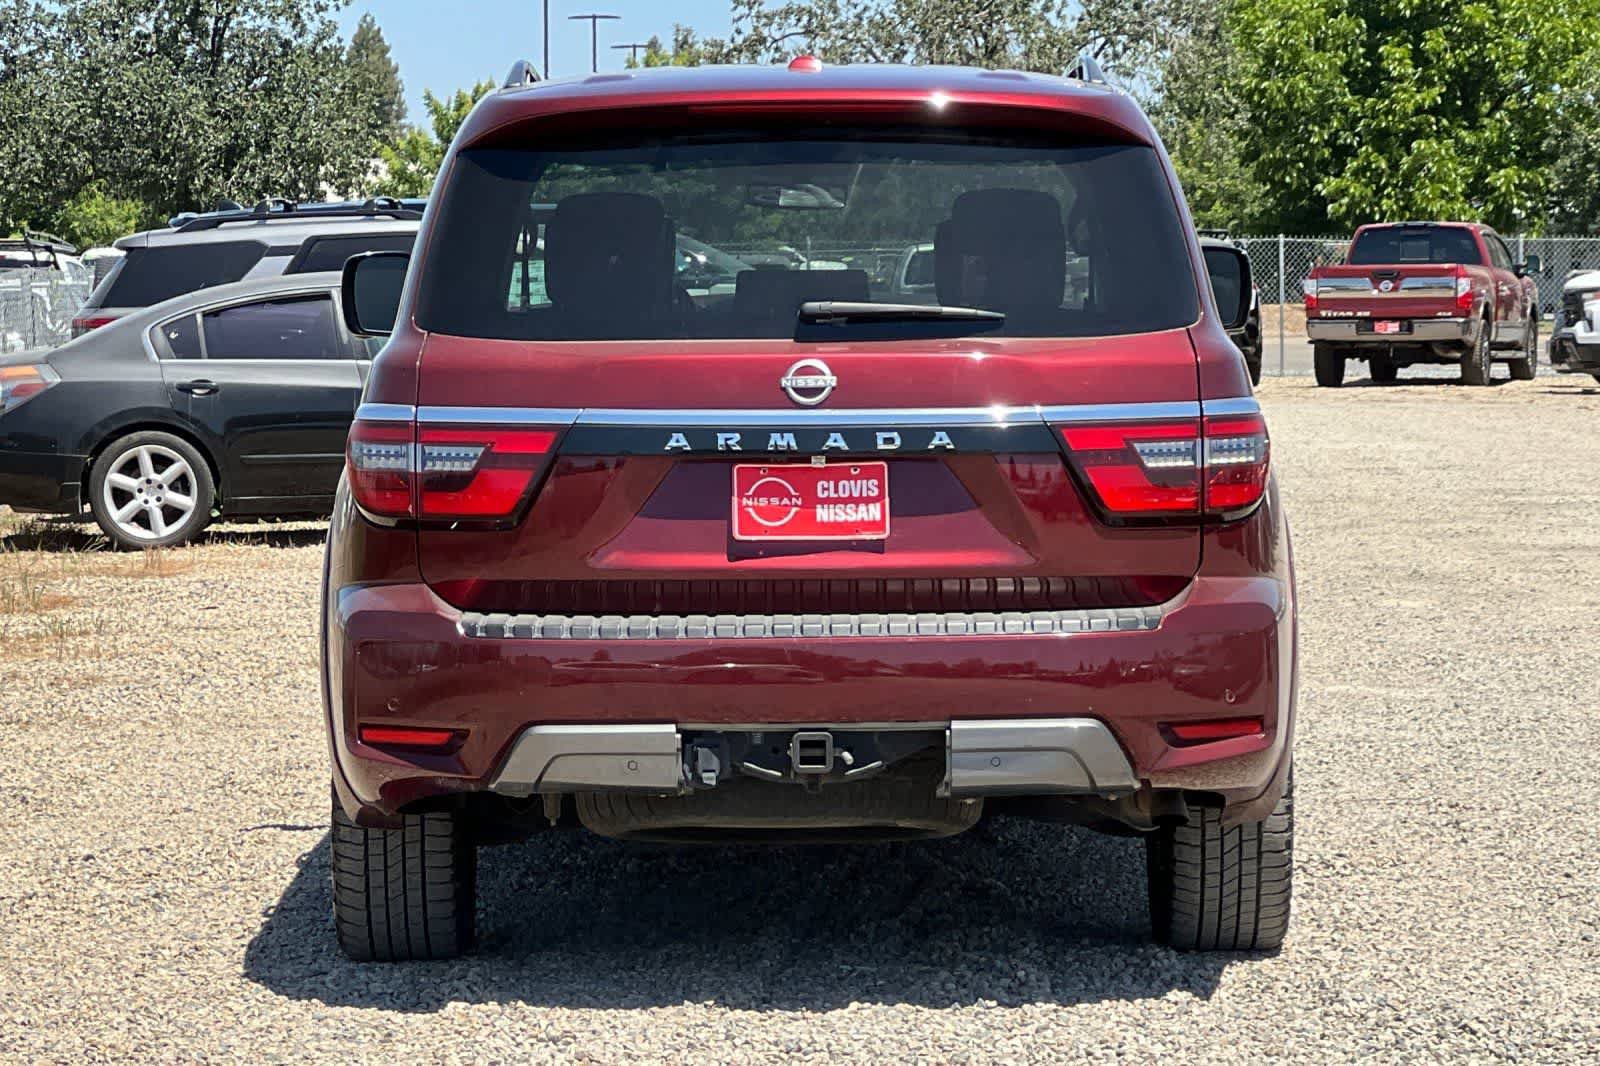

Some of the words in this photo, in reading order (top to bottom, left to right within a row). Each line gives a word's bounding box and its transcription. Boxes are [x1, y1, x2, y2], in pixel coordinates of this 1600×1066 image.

[781, 377, 837, 388] NISSAN
[664, 432, 954, 450] ARMADA
[816, 479, 879, 498] CLOVIS
[742, 497, 802, 507] NISSAN
[816, 503, 881, 522] NISSAN
